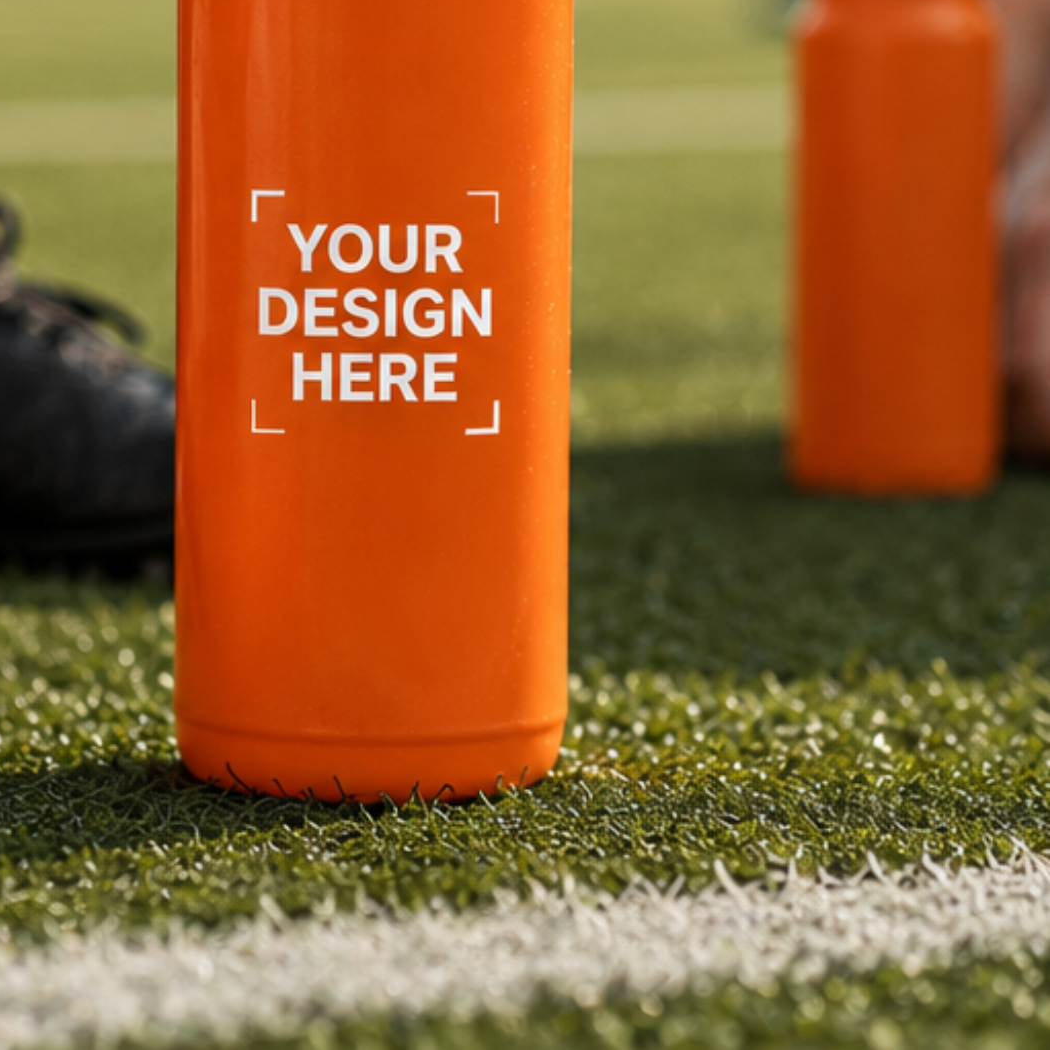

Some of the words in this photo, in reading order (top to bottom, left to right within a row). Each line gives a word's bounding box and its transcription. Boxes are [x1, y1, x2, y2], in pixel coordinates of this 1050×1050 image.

[287, 223, 463, 274] YOUR
[258, 287, 492, 338] DESIGN
[292, 352, 459, 402] HERE
